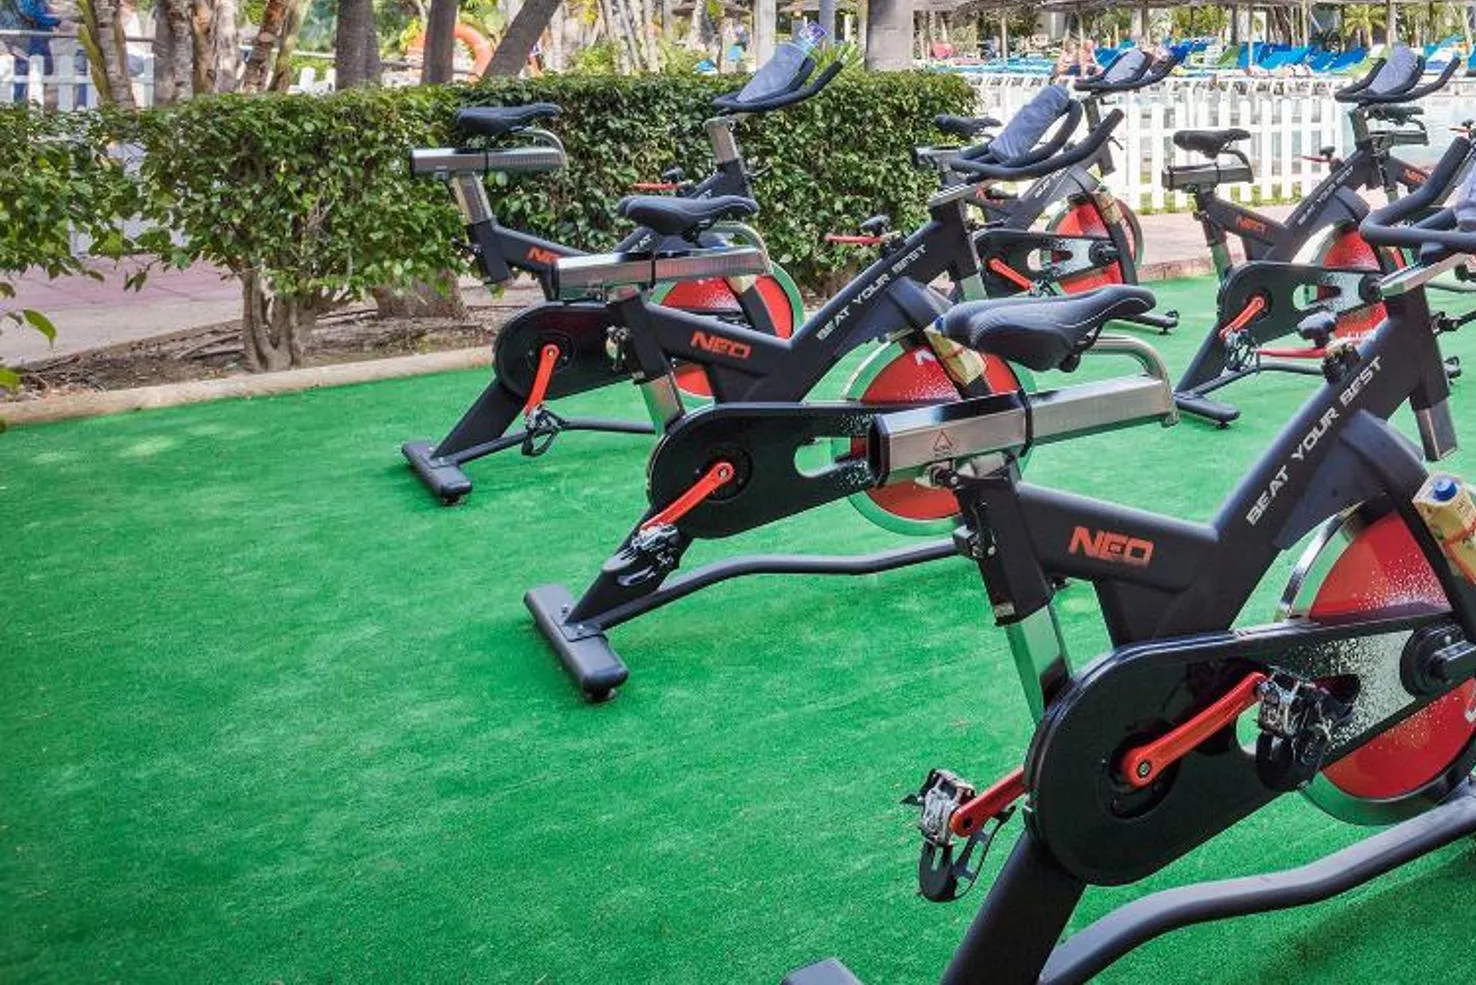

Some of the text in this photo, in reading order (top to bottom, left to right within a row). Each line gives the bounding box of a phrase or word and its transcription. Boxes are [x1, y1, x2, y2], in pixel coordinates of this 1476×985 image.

[526, 246, 562, 265] NE
[816, 305, 851, 341] BEAT
[852, 272, 892, 305] YOUR
[690, 331, 752, 360] NEO
[1245, 355, 1382, 526] BEAT YOUR BEST
[1068, 525, 1155, 567] NEO
